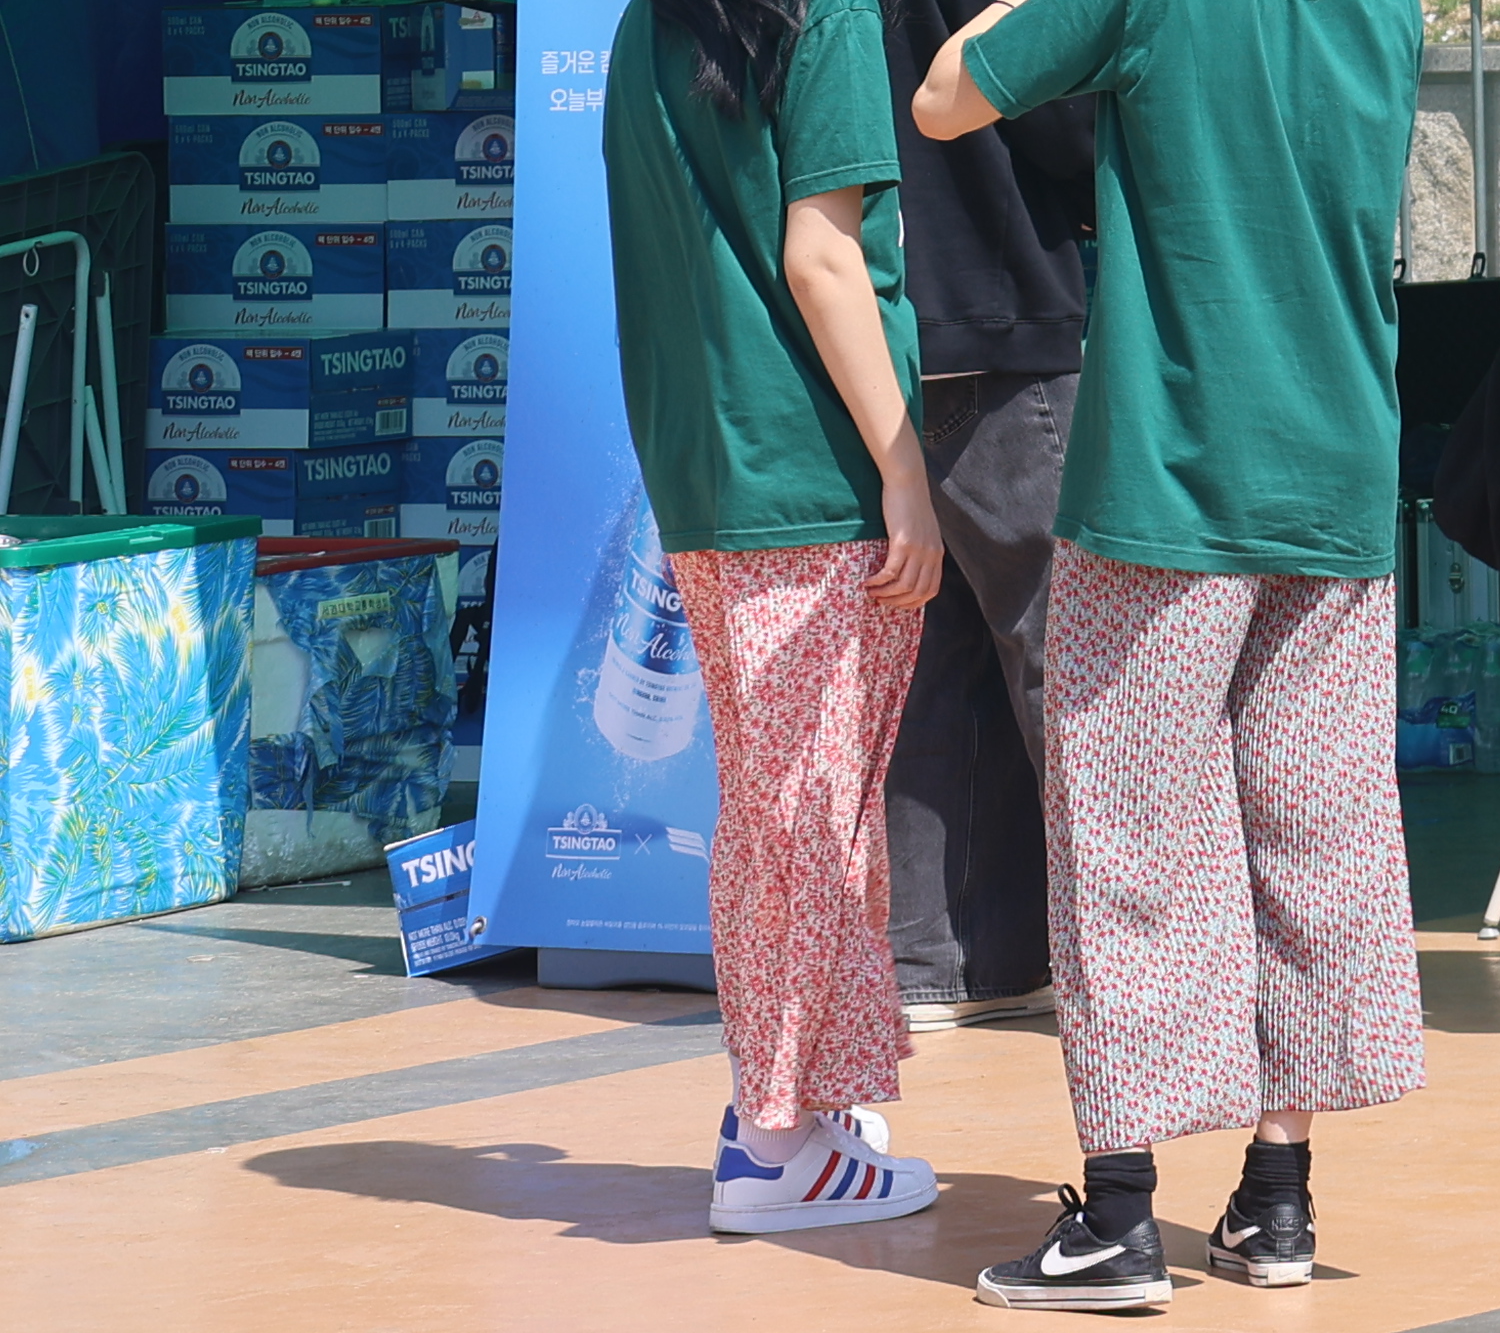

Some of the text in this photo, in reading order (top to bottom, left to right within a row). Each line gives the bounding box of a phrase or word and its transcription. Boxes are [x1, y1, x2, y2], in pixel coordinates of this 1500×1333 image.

[236, 63, 307, 77] TSINGTAO
[540, 50, 595, 75] 즐거운
[244, 171, 315, 186] TSINGTAO
[238, 281, 308, 295] TSINGTAO
[320, 346, 406, 376] TSINGTAO
[166, 395, 236, 410] TSINGTAO
[304, 452, 391, 481] TSINGTAO
[552, 836, 616, 851] TSINGTAO
[1270, 1216, 1300, 1232] NIKE
